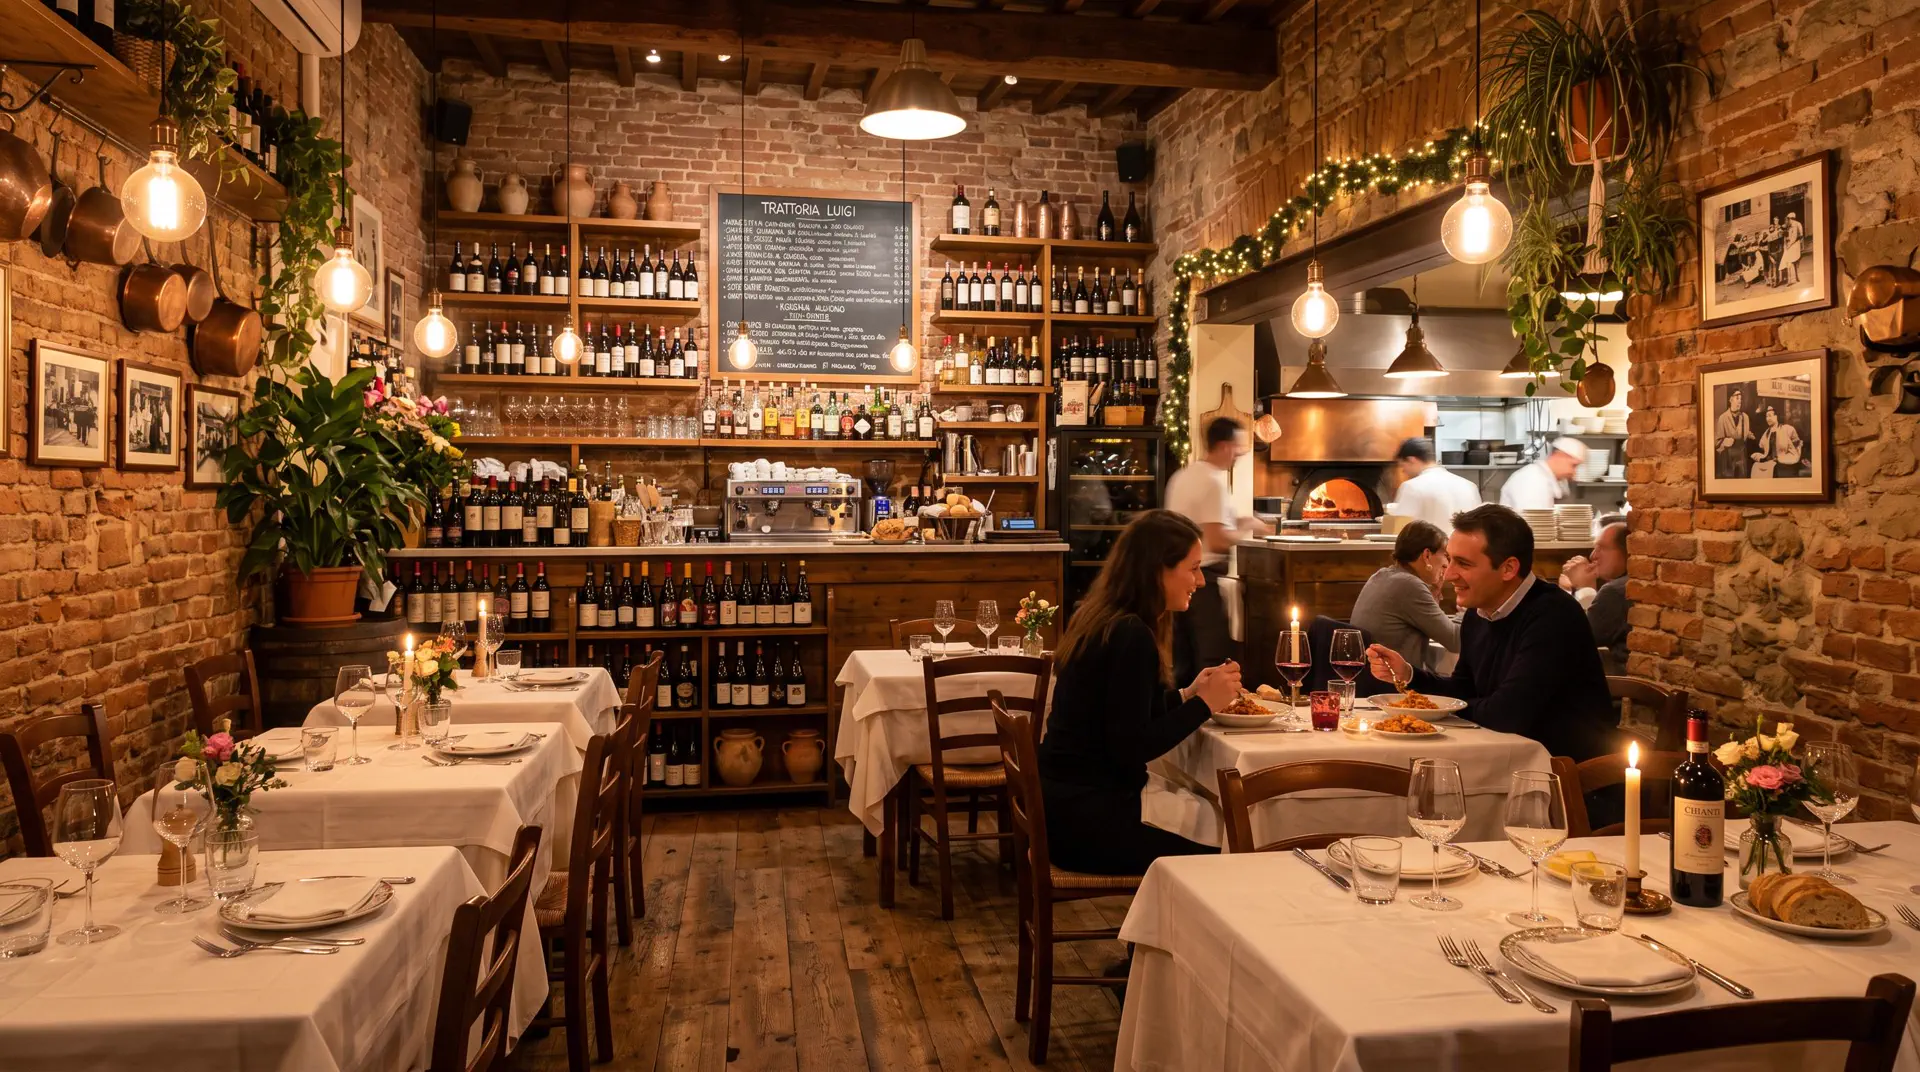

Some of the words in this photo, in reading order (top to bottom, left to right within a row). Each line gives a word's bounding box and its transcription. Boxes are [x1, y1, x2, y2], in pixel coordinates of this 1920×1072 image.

[761, 201, 820, 216] TRATTORIA
[827, 204, 856, 217] LUIGI
[1684, 806, 1720, 816] CHIANTI
